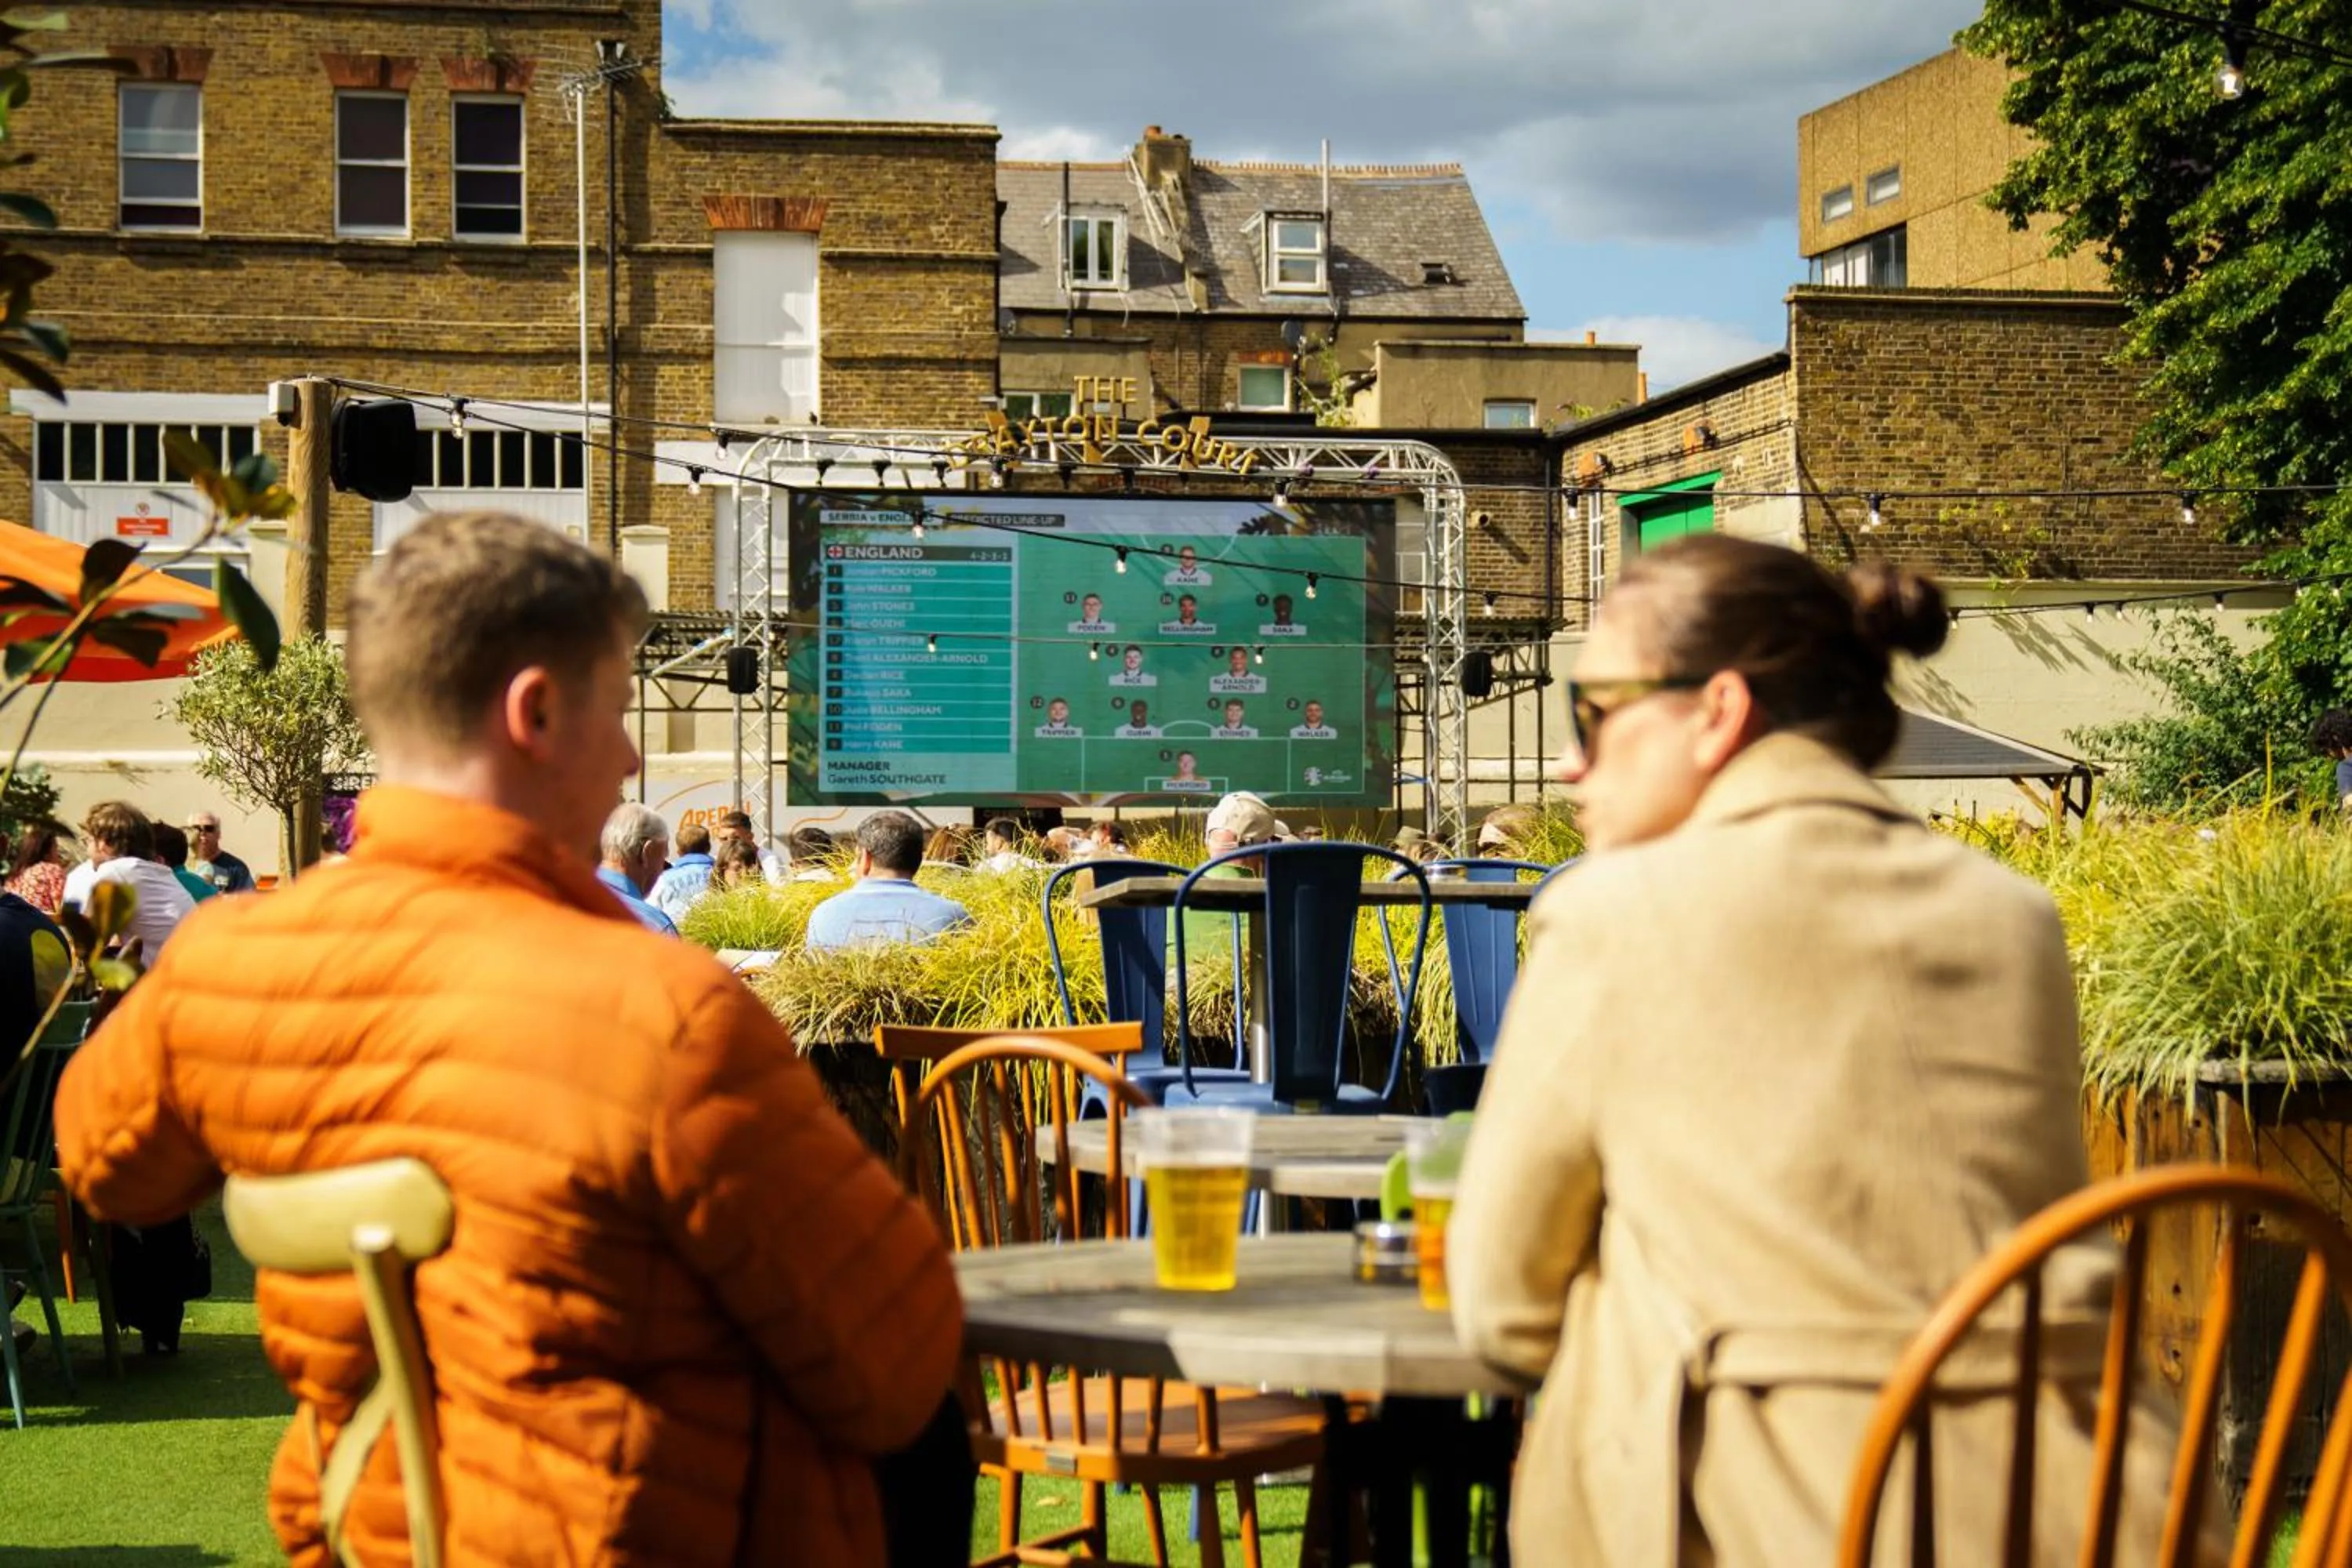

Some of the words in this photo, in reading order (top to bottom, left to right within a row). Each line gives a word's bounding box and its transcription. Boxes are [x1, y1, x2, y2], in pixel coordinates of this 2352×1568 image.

[1073, 376, 1138, 402] THE
[1138, 419, 1259, 474] COURT
[828, 513, 867, 522] SERBIA
[845, 546, 924, 559] ENGLAND
[880, 568, 938, 577] PICKFORD
[870, 705, 941, 714] BELLINGHAM
[827, 760, 891, 771] MANAGER
[331, 775, 376, 791] SIRE
[828, 774, 867, 784] Gareth
[869, 775, 946, 784] SOUTHGATE
